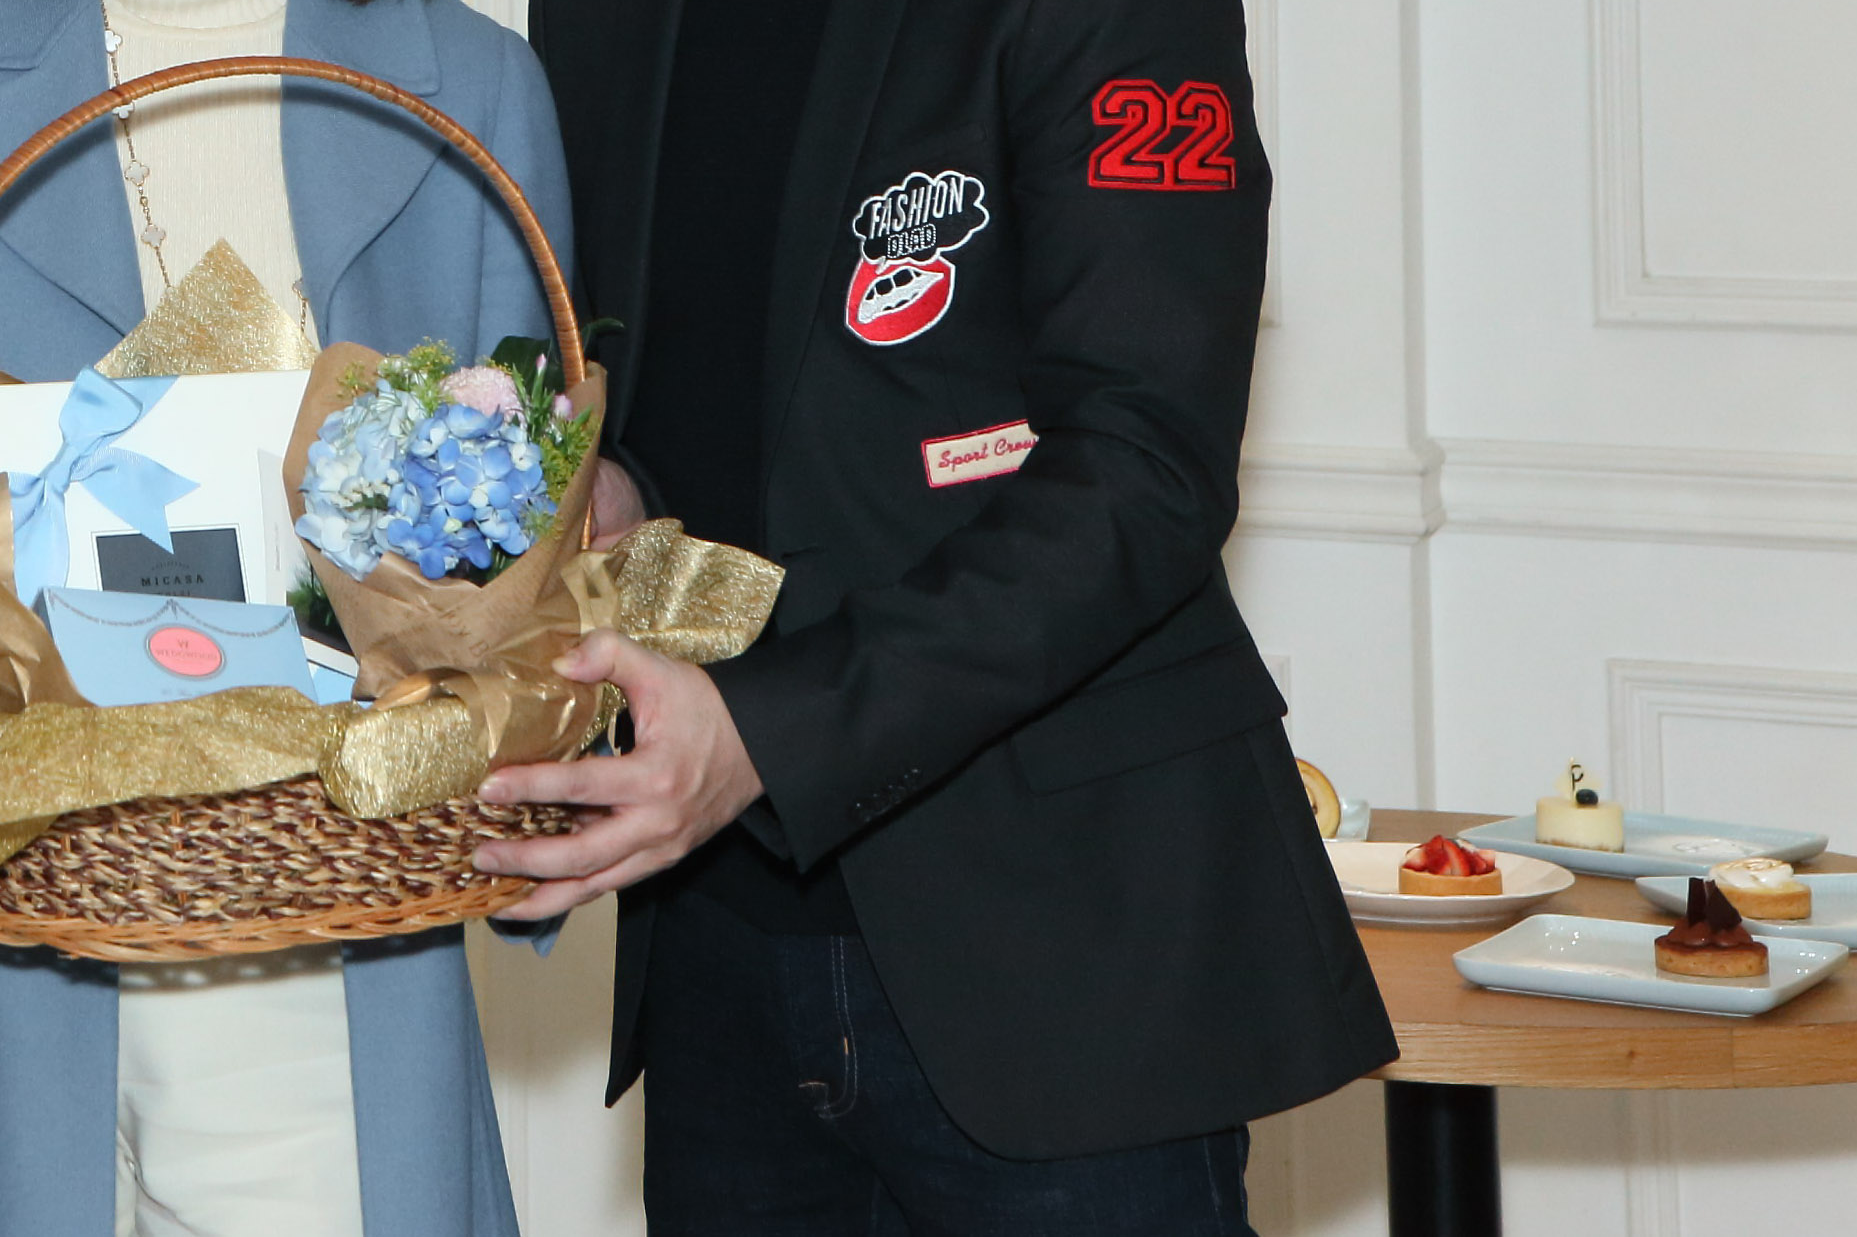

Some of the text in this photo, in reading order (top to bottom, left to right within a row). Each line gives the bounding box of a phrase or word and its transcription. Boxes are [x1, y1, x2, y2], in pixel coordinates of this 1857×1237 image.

[1088, 79, 1236, 191] 22
[868, 176, 965, 240] FASHION
[938, 443, 988, 472] Sport
[141, 573, 204, 587] MICASA
